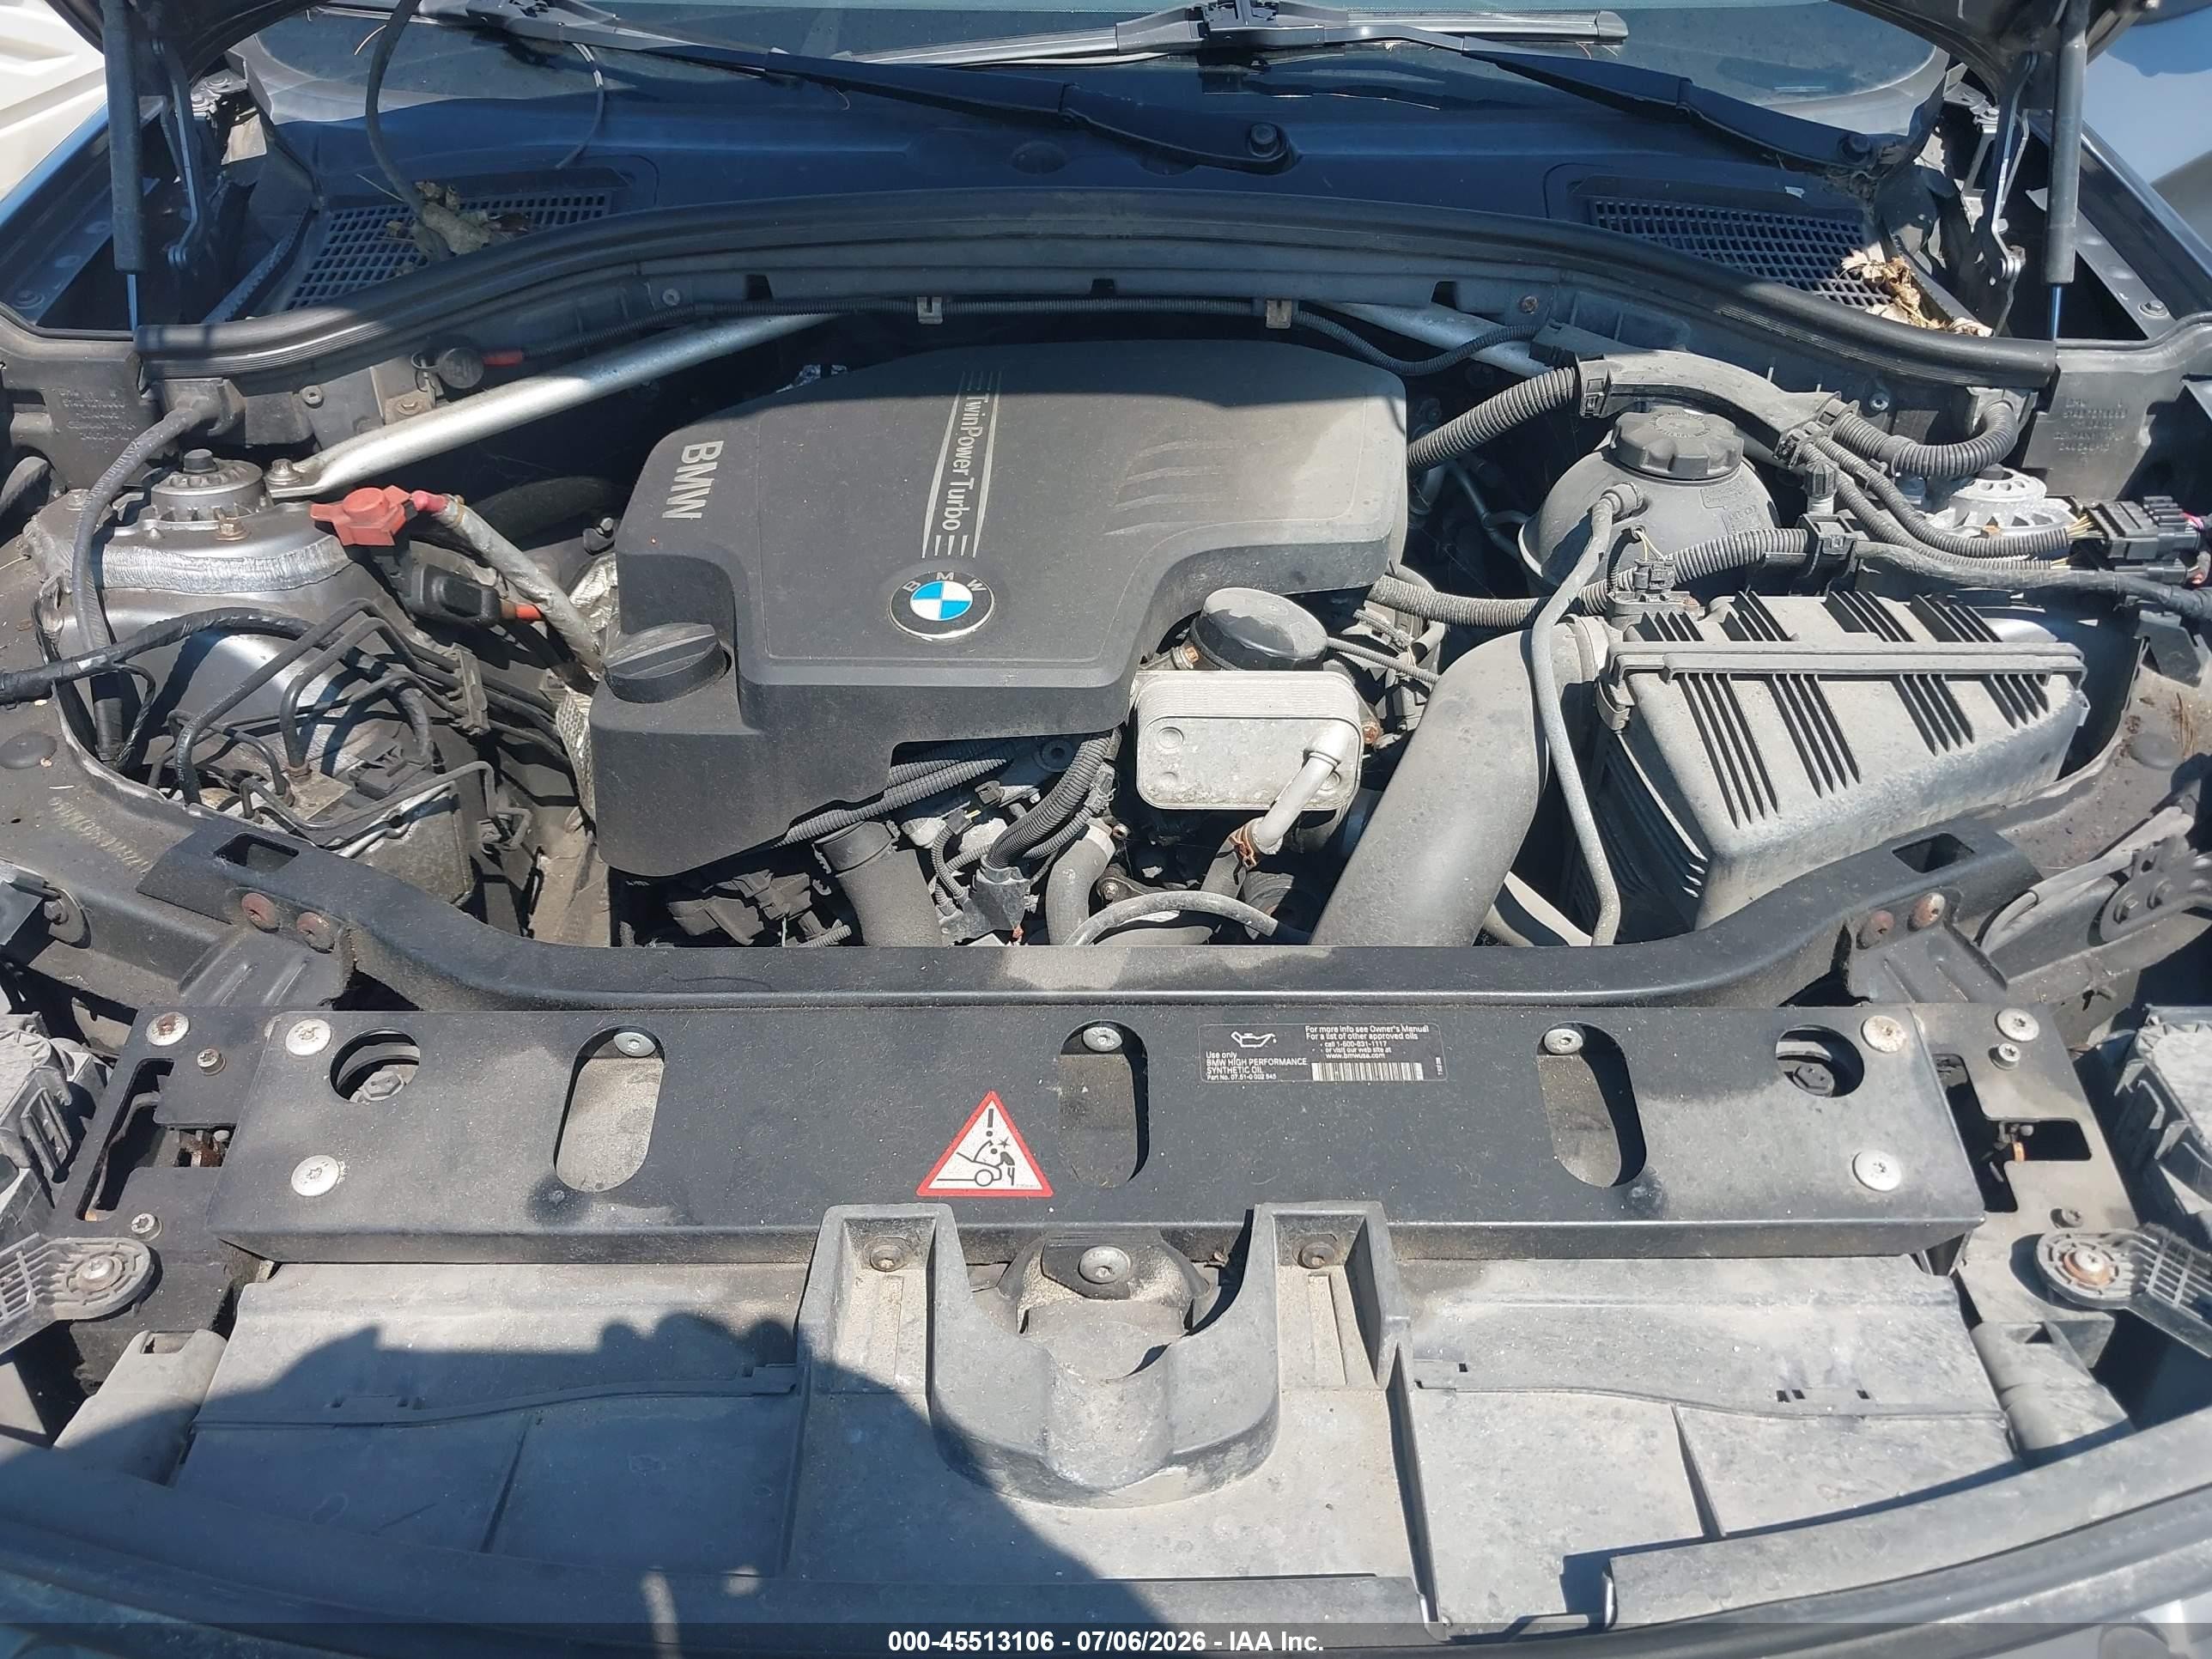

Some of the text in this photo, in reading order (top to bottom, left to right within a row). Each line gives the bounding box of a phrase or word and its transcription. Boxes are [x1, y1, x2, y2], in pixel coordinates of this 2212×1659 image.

[942, 394, 989, 532] TwinPower Turbo
[661, 440, 725, 520] BMW
[902, 571, 988, 592] BMW
[1370, 1024, 1400, 1033] Owner's
[1401, 1024, 1430, 1033] Manual
[1369, 1033, 1404, 1042] approved
[1206, 1050, 1237, 1060] Use only
[1206, 1058, 1226, 1066] BMW
[1249, 1057, 1307, 1066] PERFORMANCE
[1206, 1066, 1250, 1074] SYNTHETIC
